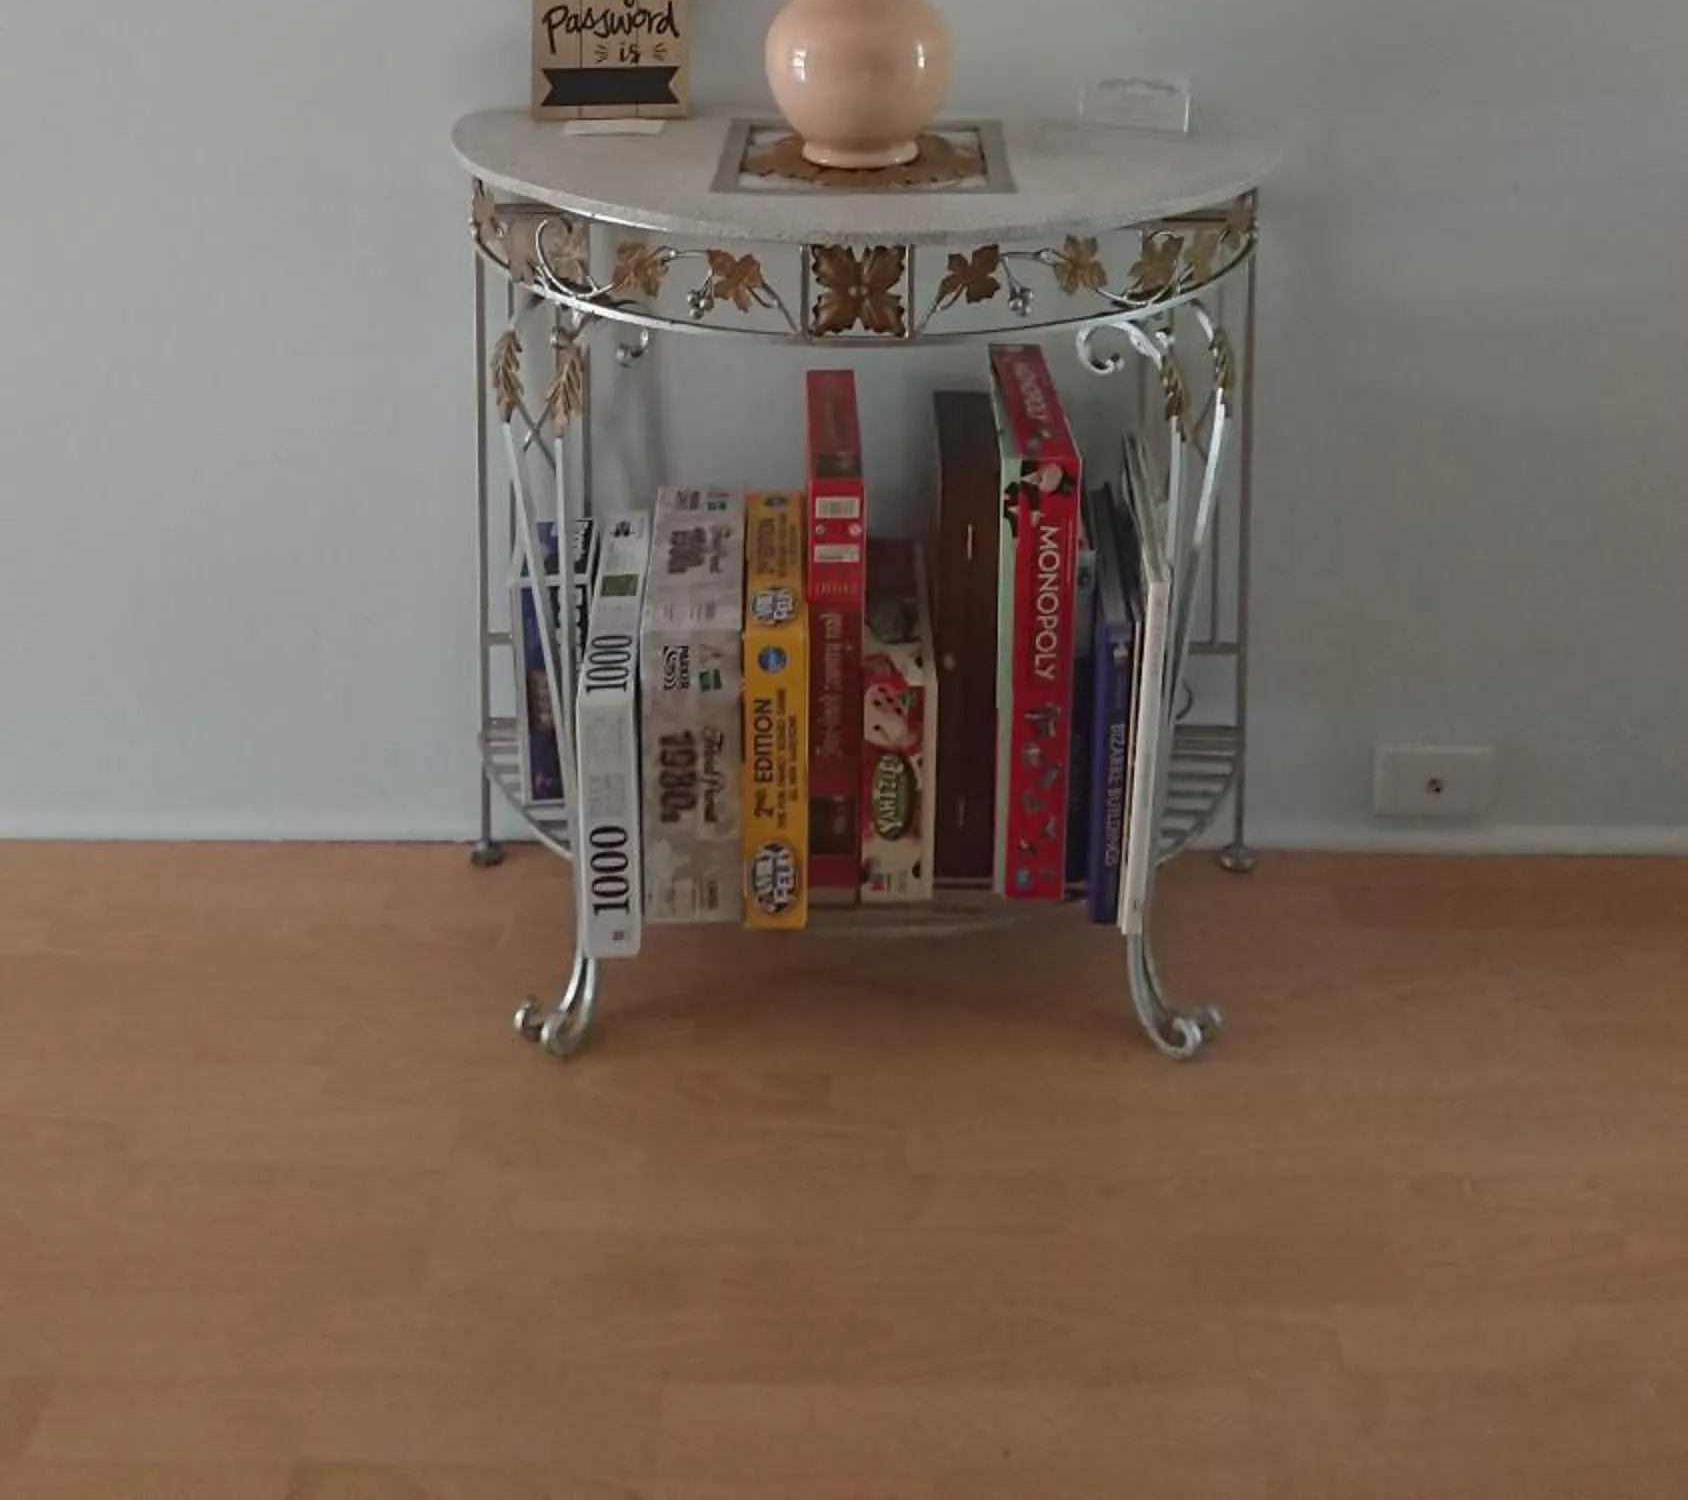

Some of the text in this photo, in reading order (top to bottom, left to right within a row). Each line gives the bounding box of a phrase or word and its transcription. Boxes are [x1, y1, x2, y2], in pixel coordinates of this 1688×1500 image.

[619, 42, 641, 64] is
[1033, 524, 1062, 681] MONOPOLY
[585, 634, 633, 694] 1000
[752, 698, 774, 784] EDITION
[589, 825, 630, 917] 1000
